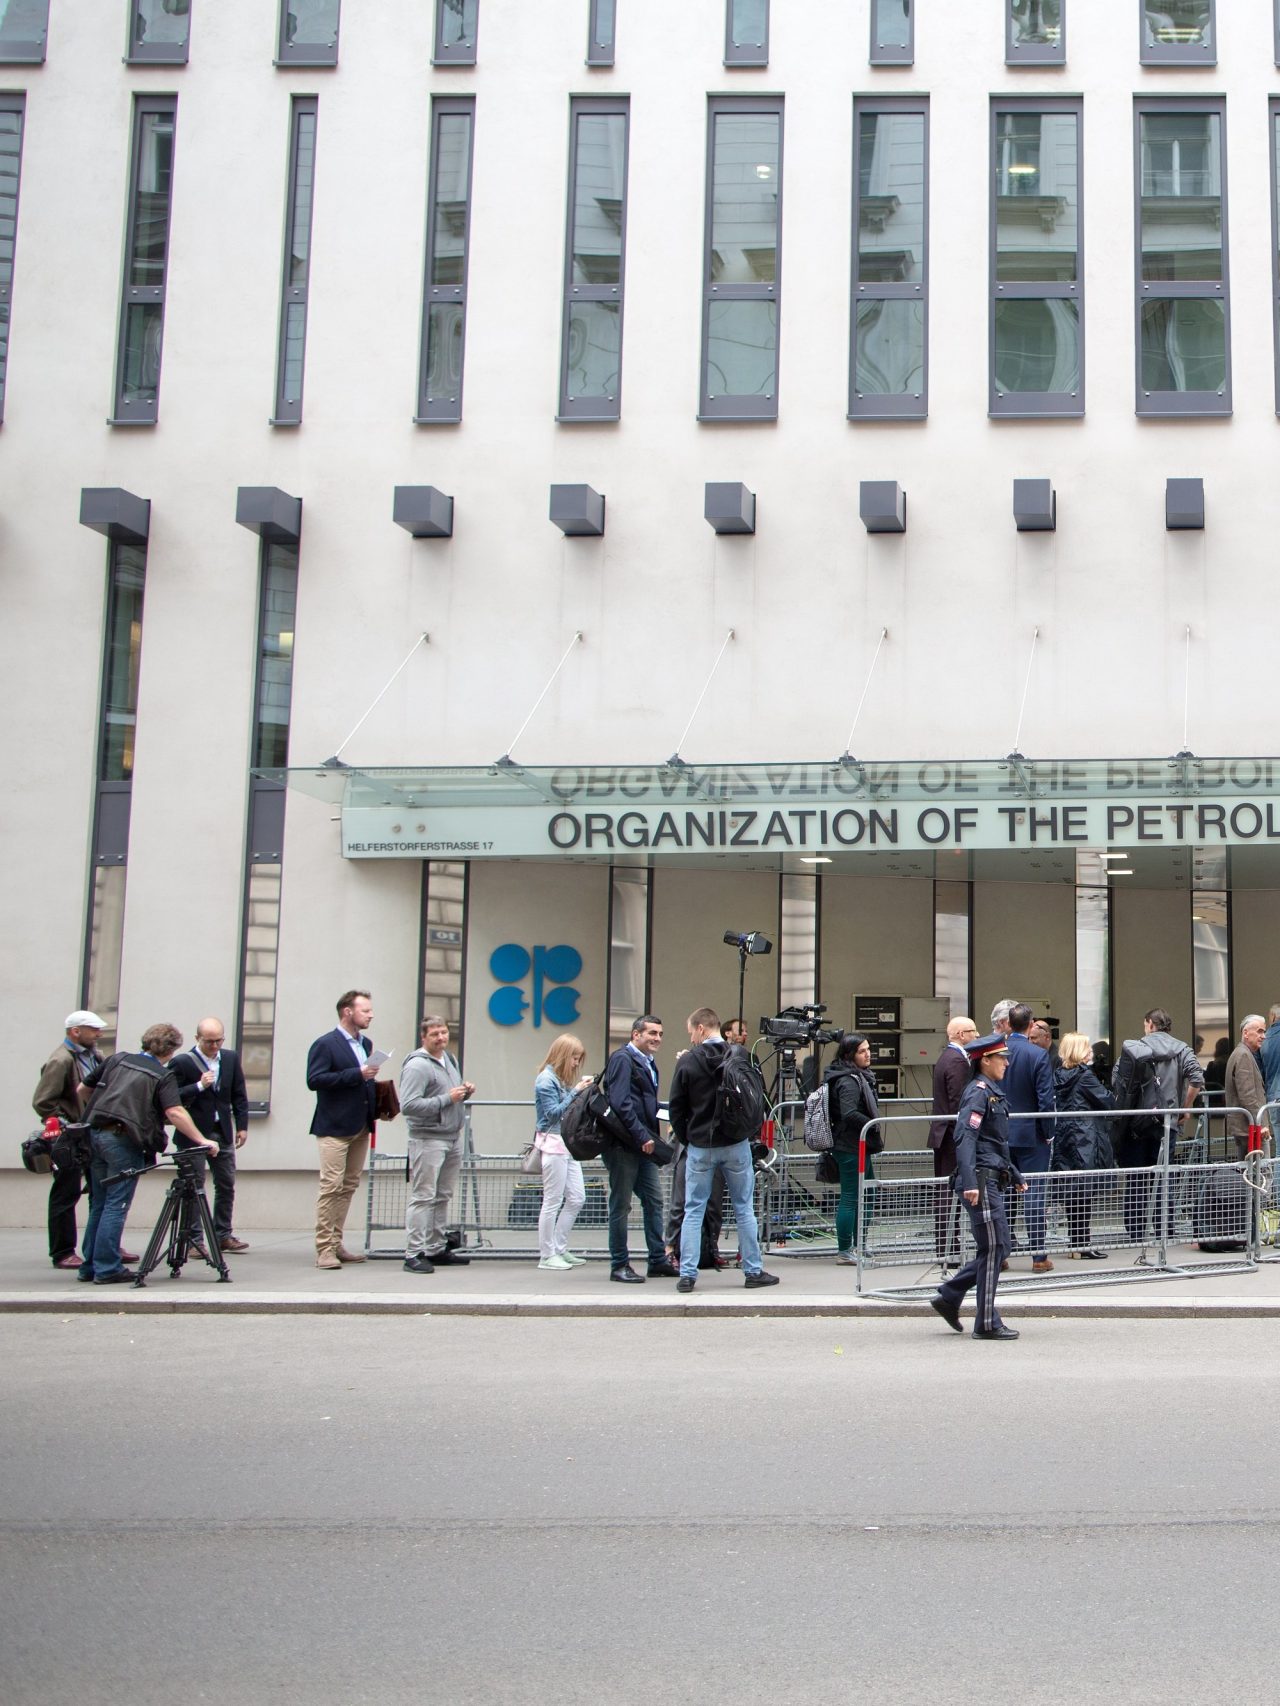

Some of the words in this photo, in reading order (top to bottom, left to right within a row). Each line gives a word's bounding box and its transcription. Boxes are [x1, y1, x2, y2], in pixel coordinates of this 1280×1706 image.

[548, 808, 898, 849] ORGANIZATION
[917, 807, 979, 844] OF
[997, 805, 1088, 842] THE
[347, 842, 480, 852] HELFERSTORFERSTRASSE
[482, 841, 494, 850] 17
